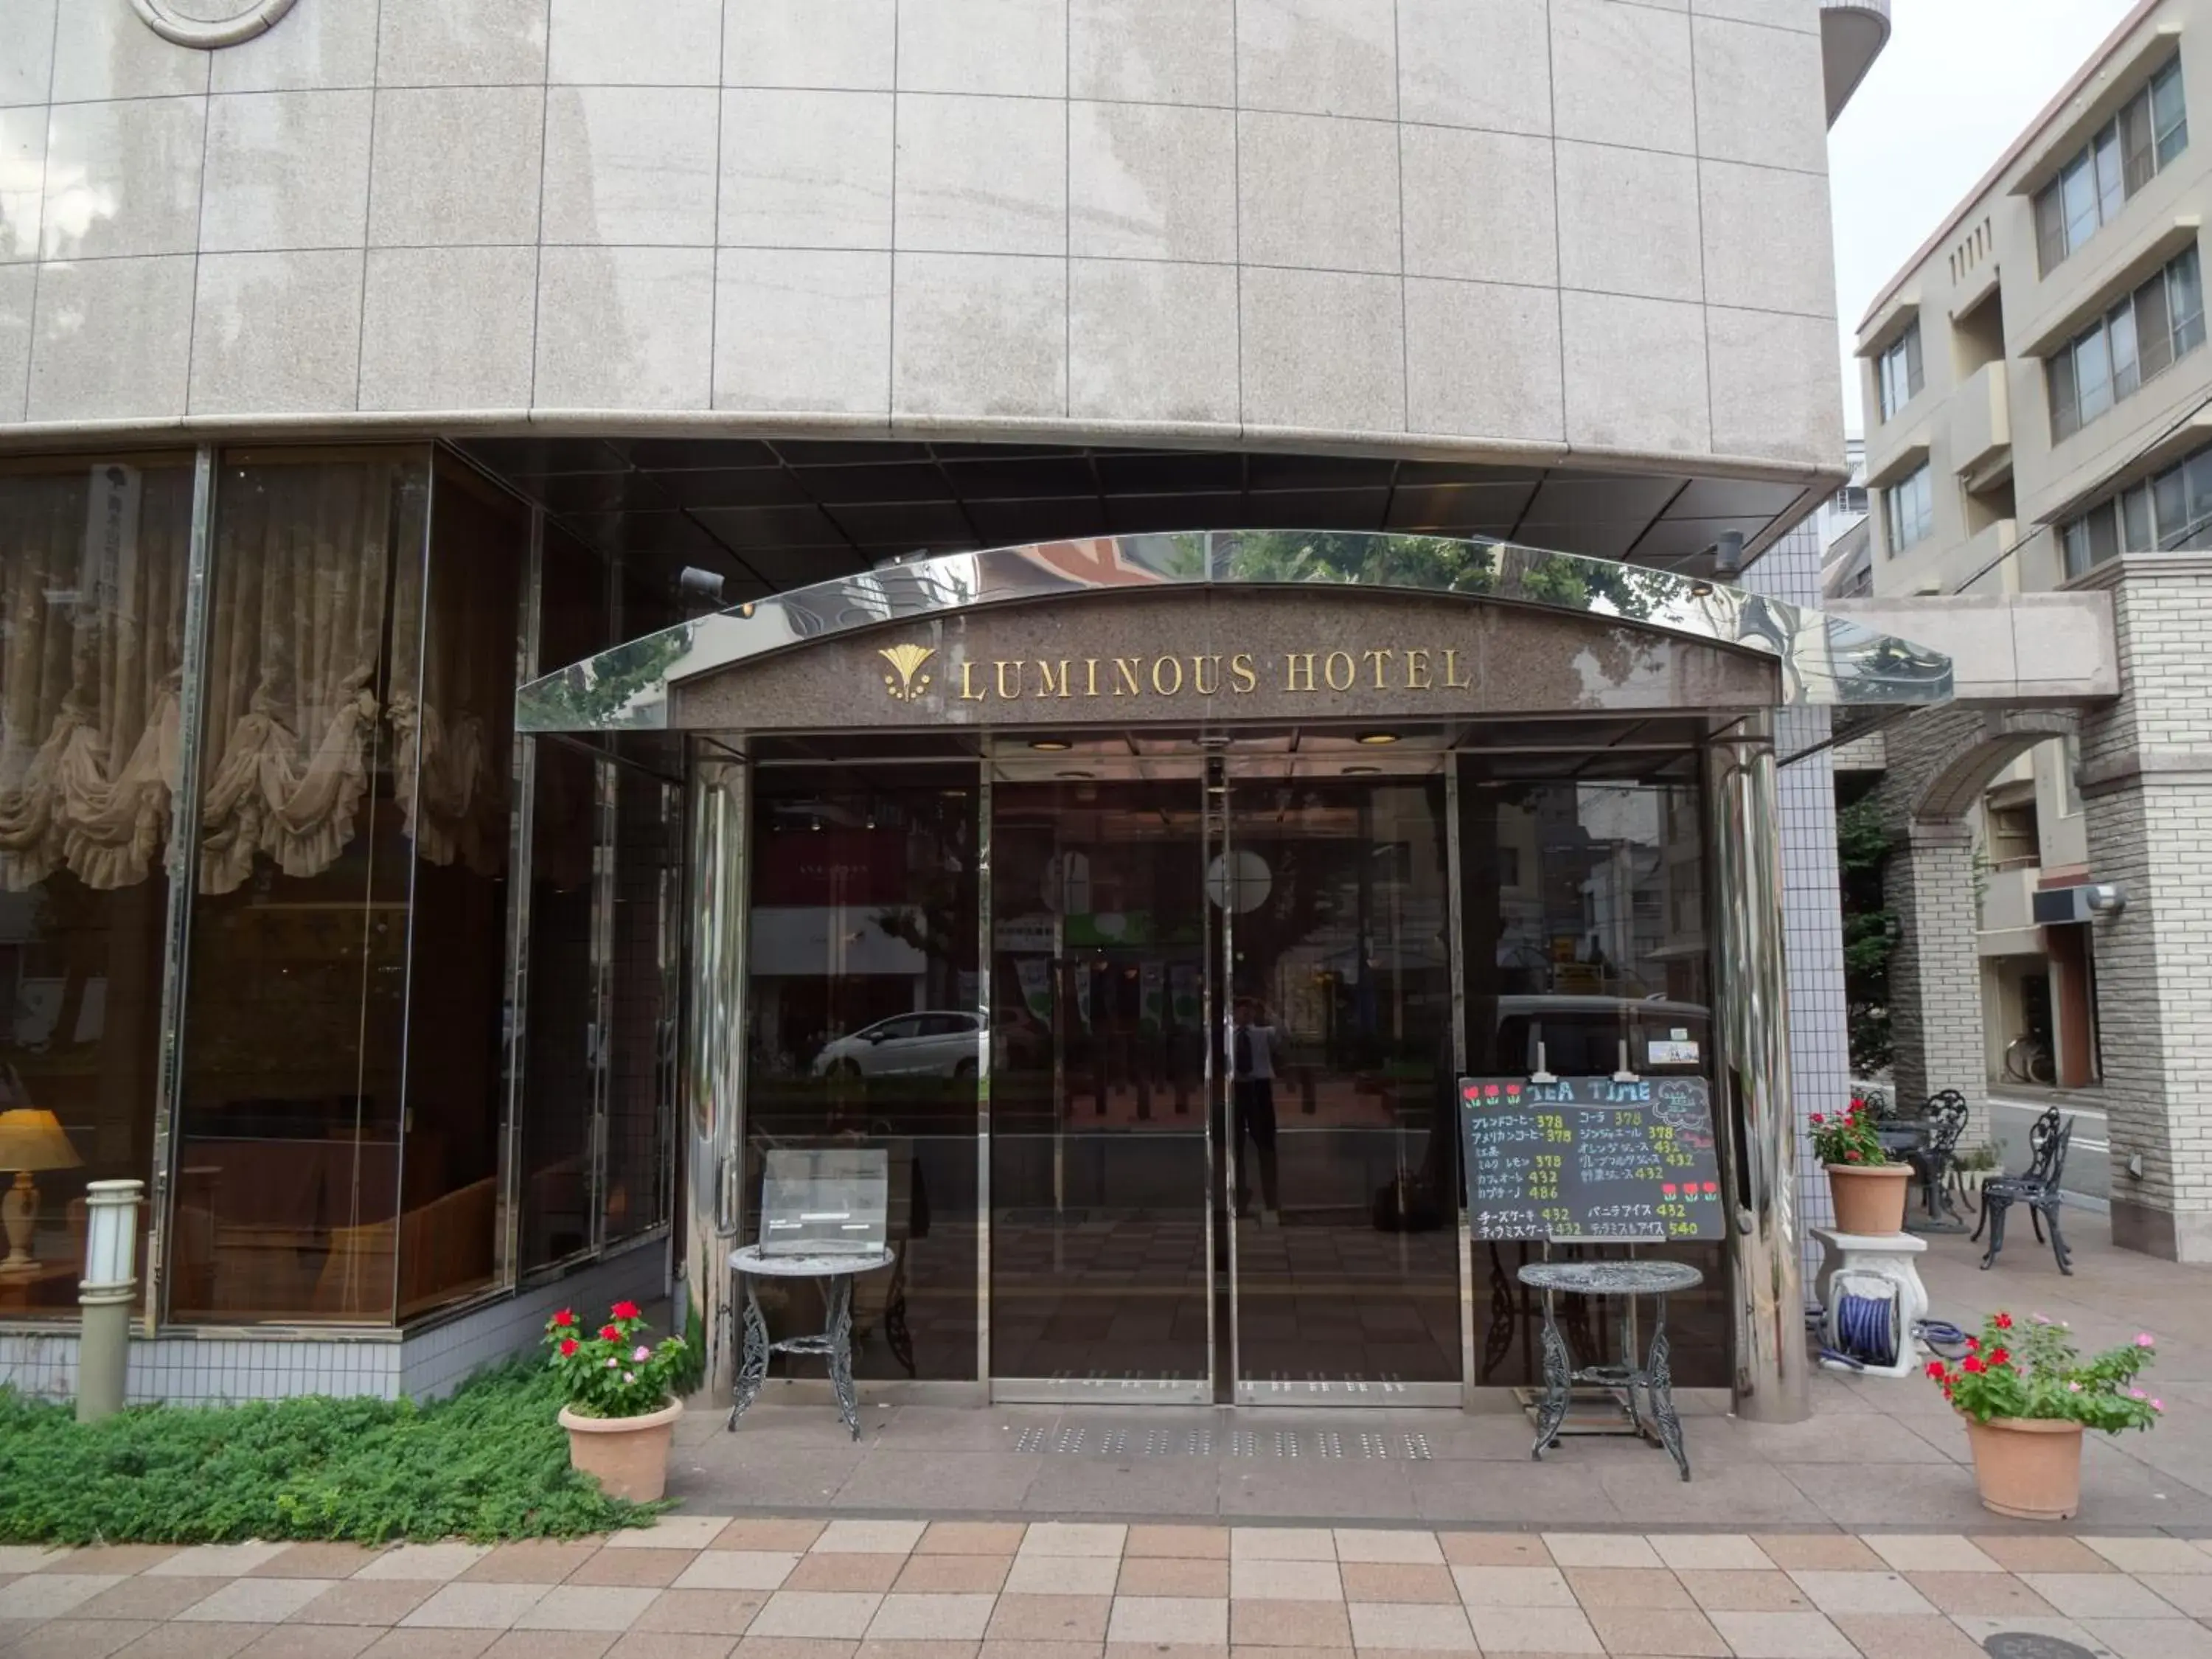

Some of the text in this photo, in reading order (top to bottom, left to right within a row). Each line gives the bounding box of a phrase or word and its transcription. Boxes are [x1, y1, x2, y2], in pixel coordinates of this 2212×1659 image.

[959, 648, 1472, 701] LUMINOUS HOTEL
[1526, 1081, 1575, 1102] TEA
[1588, 1081, 1651, 1102] TIME
[1537, 1114, 1564, 1129] 378
[1579, 1110, 1643, 1126] コーラ 378
[1546, 1129, 1572, 1143] 378
[1648, 1126, 1675, 1140] 378
[1653, 1140, 1680, 1154] 432
[1535, 1155, 1562, 1168] 378
[1665, 1153, 1696, 1167] 432
[1528, 1170, 1558, 1184] 432
[1635, 1167, 1664, 1181] 432
[1528, 1186, 1558, 1200] 486
[1478, 1208, 1571, 1224] チーズケーキ 432
[1655, 1203, 1686, 1218] 432
[1555, 1222, 1582, 1237] 432
[1669, 1221, 1698, 1237] 540
